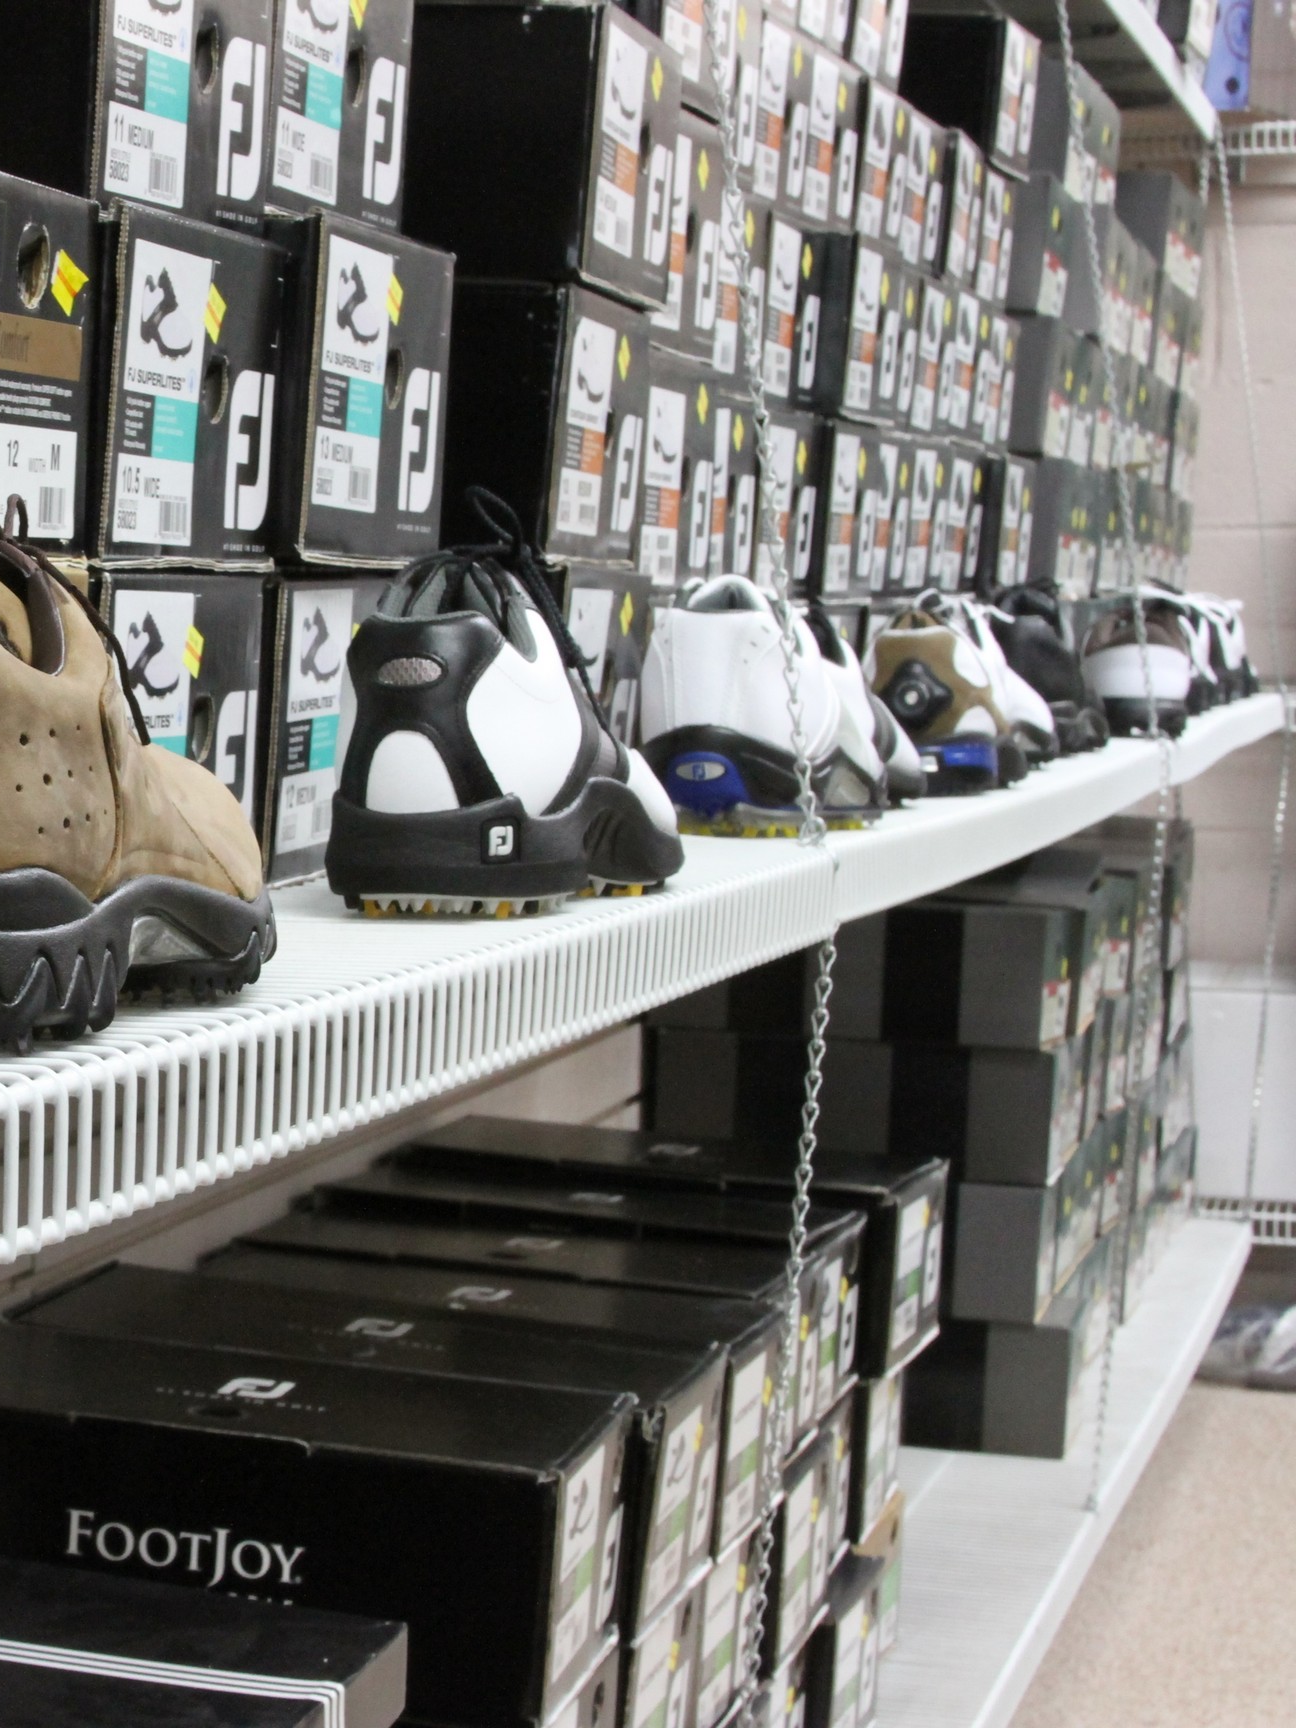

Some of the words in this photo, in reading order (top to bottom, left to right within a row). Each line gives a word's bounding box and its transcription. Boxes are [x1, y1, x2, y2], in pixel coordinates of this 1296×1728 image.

[114, 112, 124, 143] 11
[7, 439, 20, 468] 12
[50, 443, 61, 471] M
[122, 465, 141, 494] 10.5
[488, 825, 513, 857] FJ
